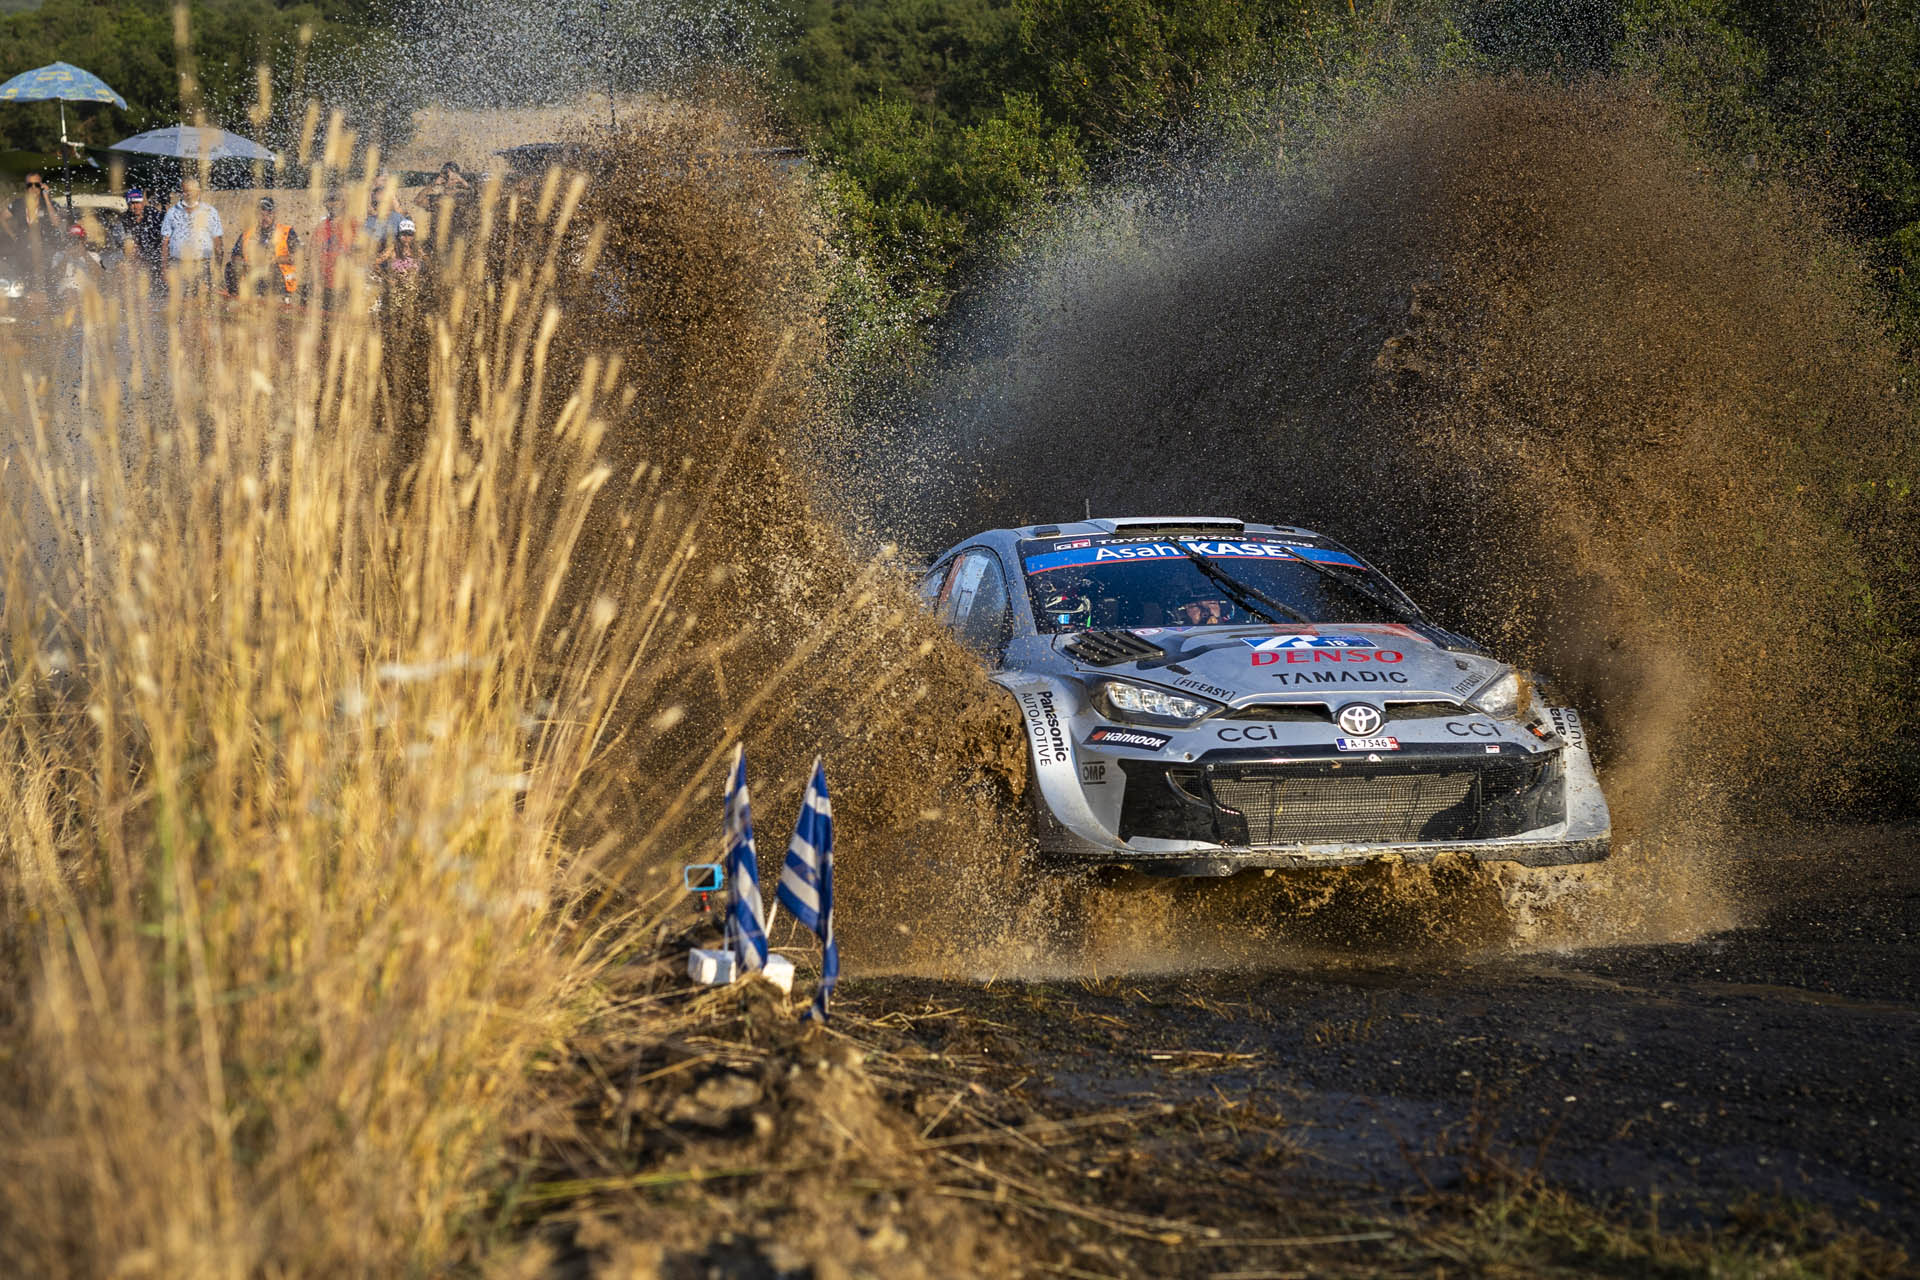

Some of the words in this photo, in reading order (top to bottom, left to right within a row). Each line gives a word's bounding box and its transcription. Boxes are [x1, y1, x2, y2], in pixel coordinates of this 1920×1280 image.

[1056, 540, 1090, 550] GR
[1251, 650, 1404, 667] DENSO
[1272, 671, 1408, 685] TAMADIC
[1021, 692, 1052, 767] AUTOMOTIVE
[1037, 690, 1069, 762] Panasonic
[1350, 739, 1388, 748] A-7546
[1082, 765, 1106, 781] OMP
